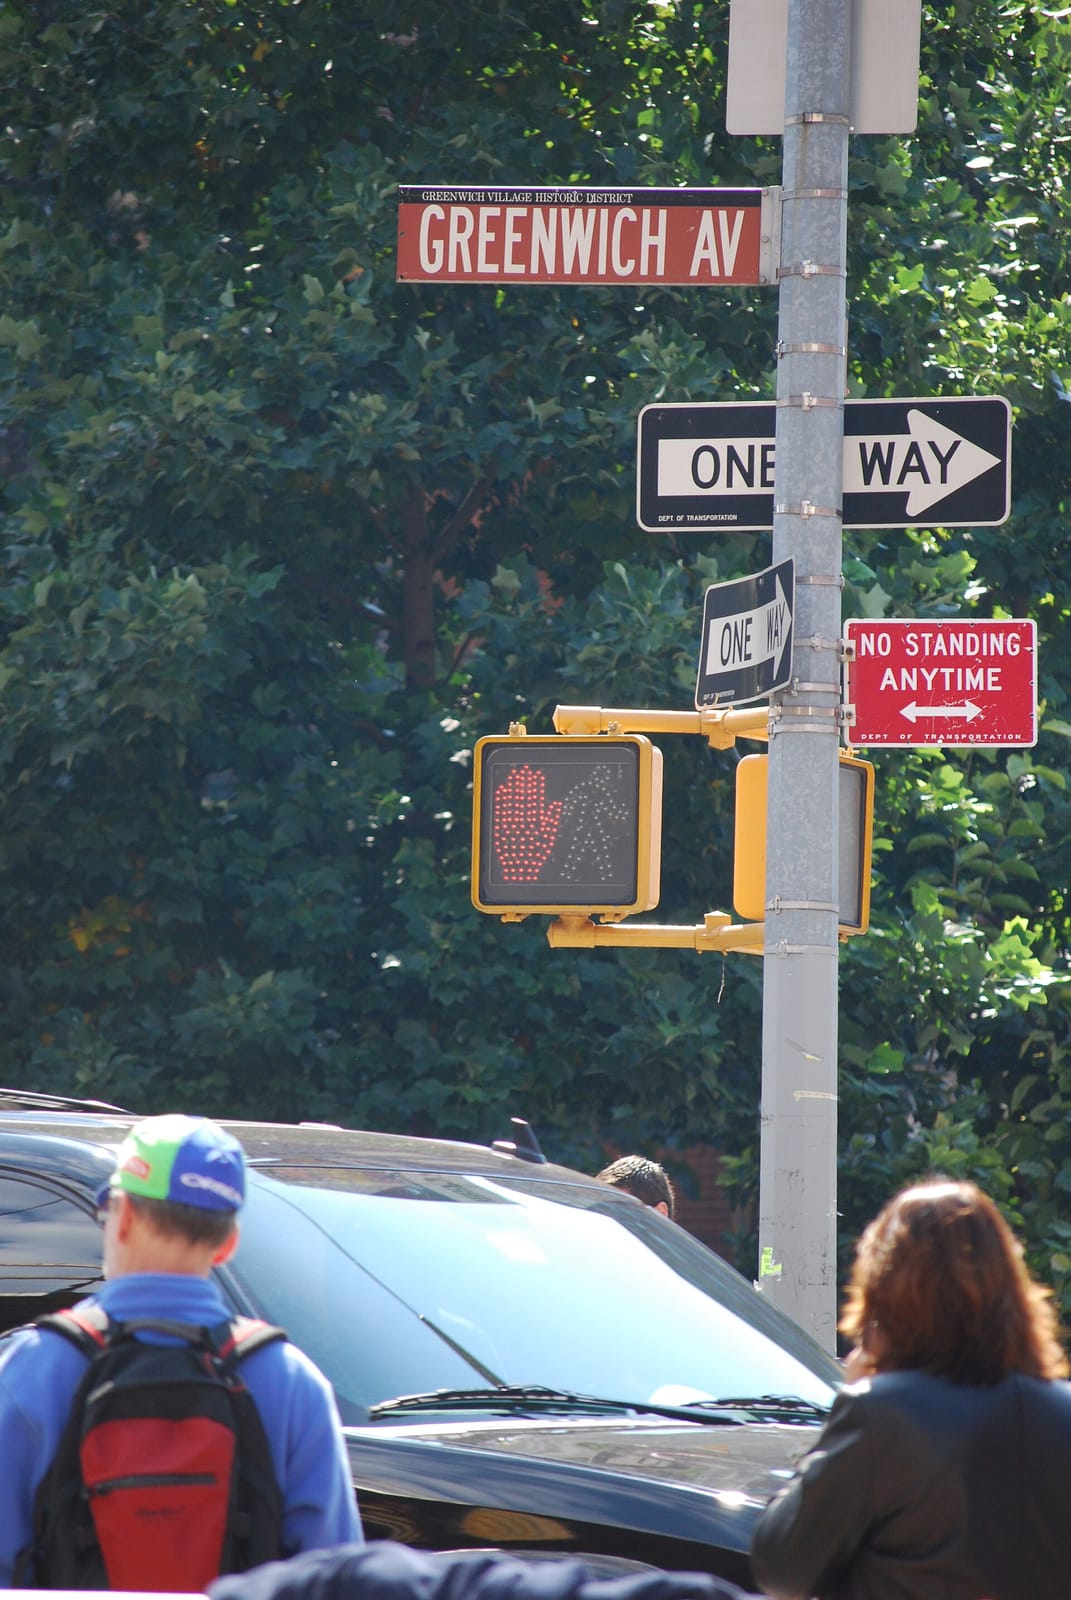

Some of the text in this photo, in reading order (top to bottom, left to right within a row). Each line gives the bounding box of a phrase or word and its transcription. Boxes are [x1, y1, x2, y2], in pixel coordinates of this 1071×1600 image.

[422, 191, 634, 204] GREENWICH VILLAGE HISTORIC DISTRICT
[419, 204, 746, 277] GREENWICH AV
[691, 440, 962, 490] ONE WAY
[676, 514, 684, 522] OF
[686, 513, 738, 522] TRANSPORTATION
[720, 601, 786, 666] ONE WAY
[861, 632, 1021, 656] NO STANDING
[879, 667, 1003, 691] ANYTIME
